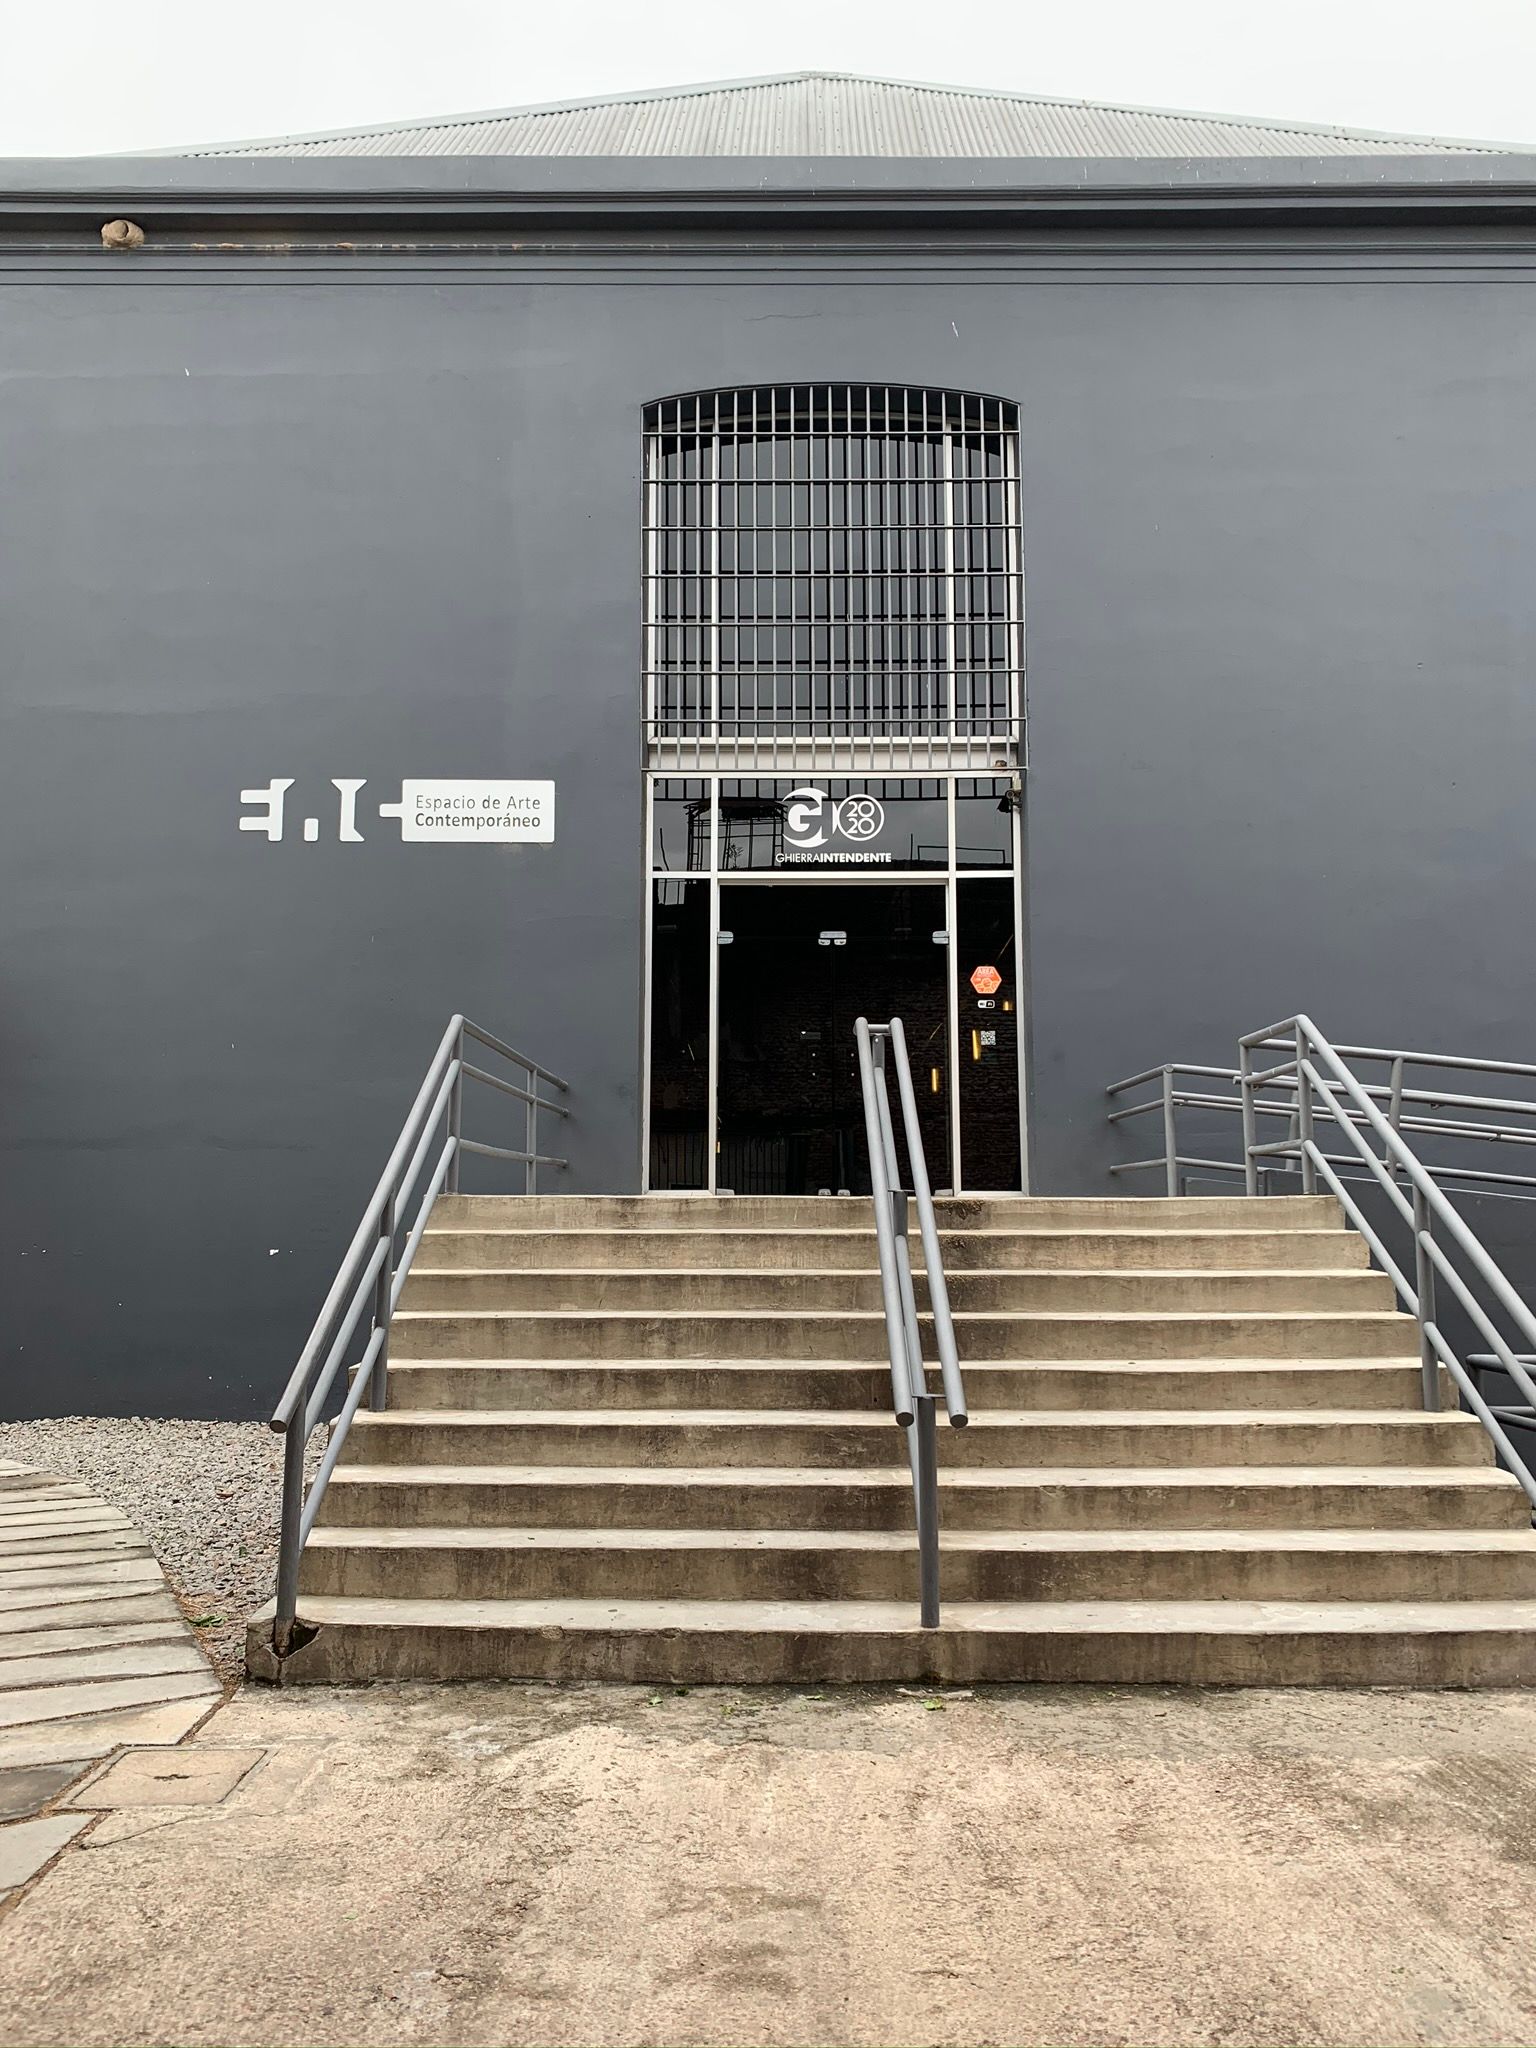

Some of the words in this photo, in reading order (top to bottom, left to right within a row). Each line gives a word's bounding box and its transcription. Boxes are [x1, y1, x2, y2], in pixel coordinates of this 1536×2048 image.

[416, 795, 476, 811] Espacio
[482, 795, 501, 809] de
[506, 796, 541, 809] Arte
[415, 812, 541, 830] Contemporáneo
